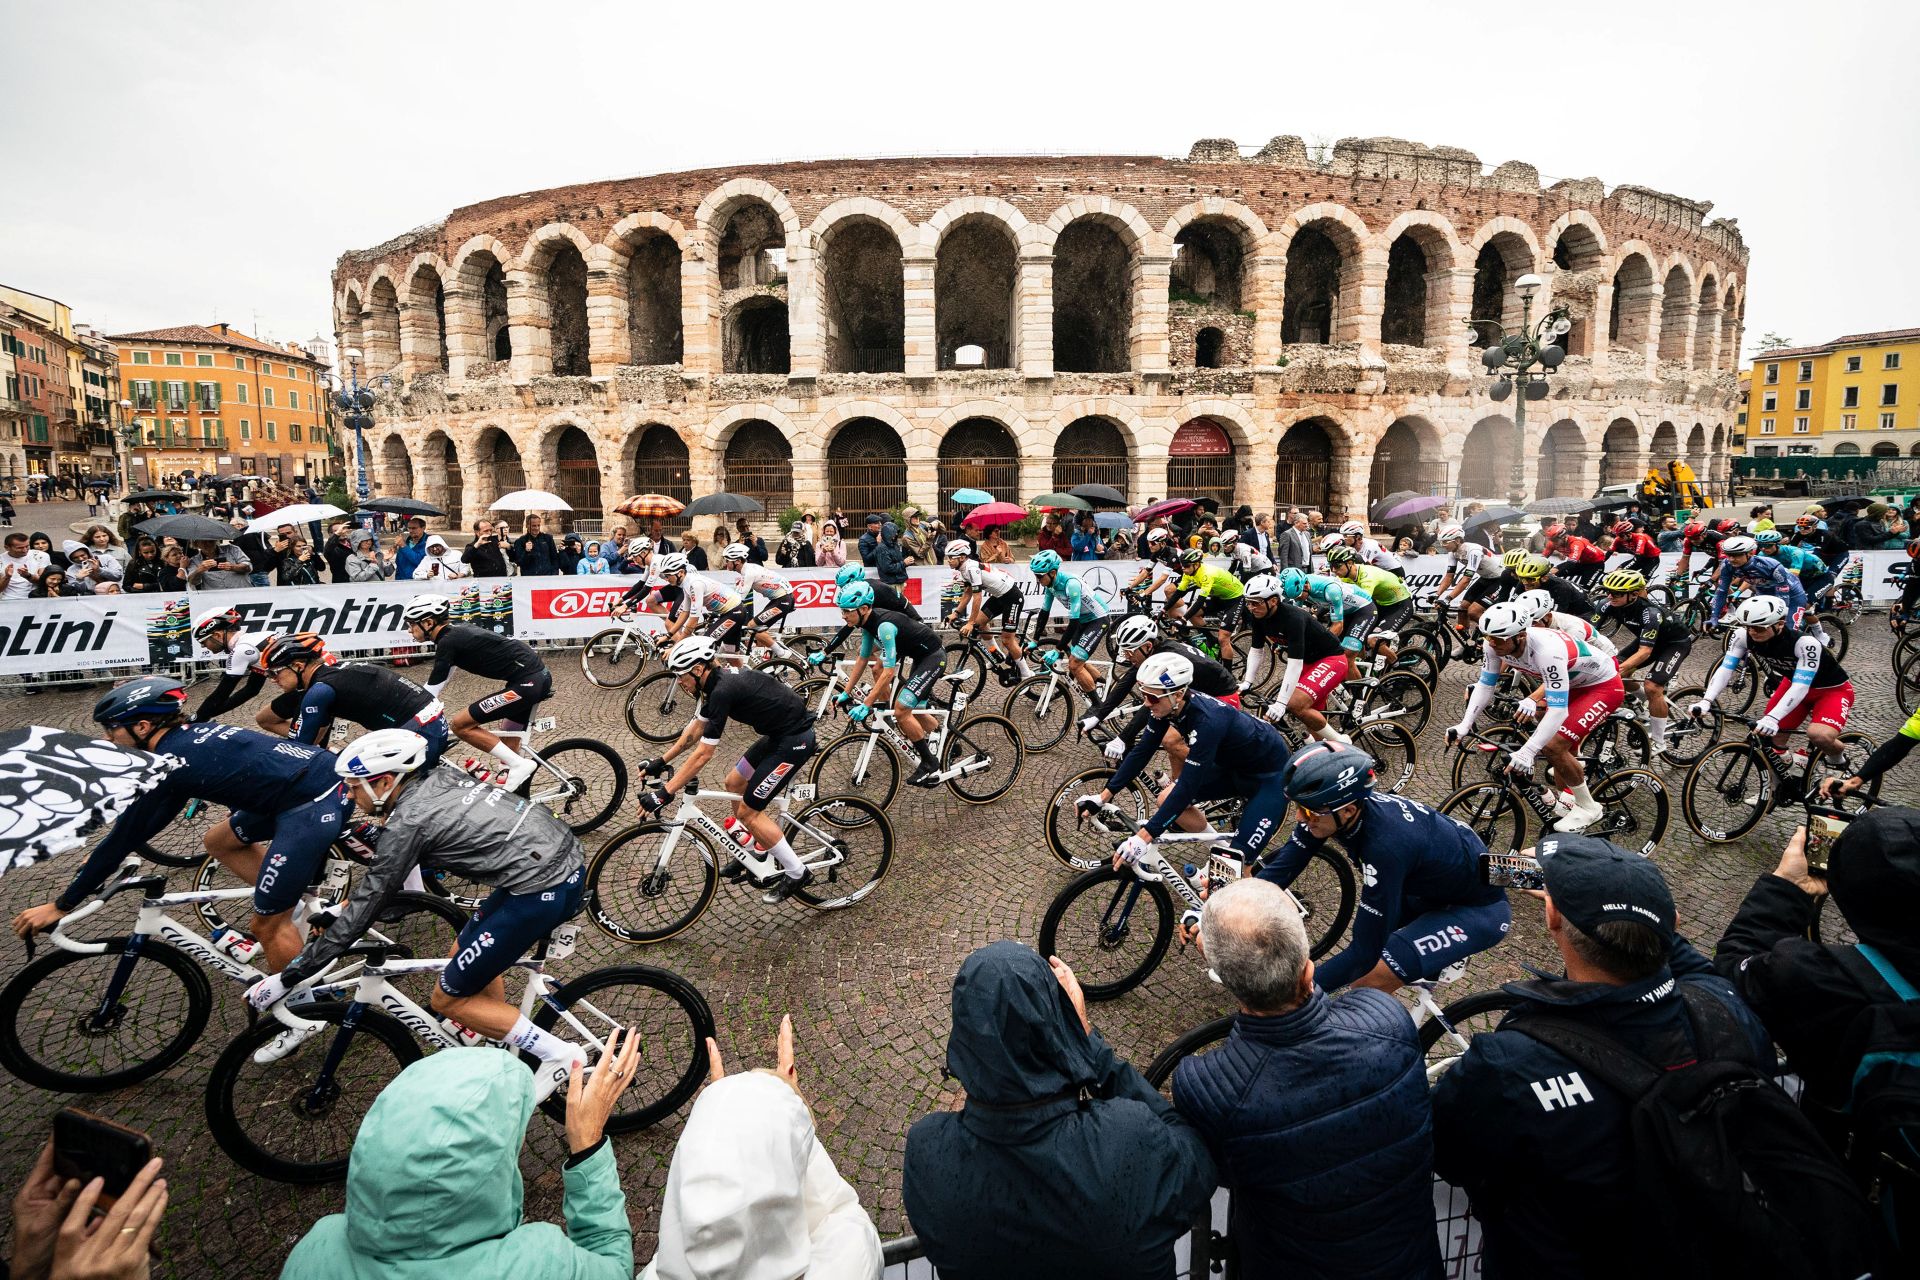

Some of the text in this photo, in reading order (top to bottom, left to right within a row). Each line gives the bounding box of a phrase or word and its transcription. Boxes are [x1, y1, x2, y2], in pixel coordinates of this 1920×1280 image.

[104, 657, 145, 665] DREAMLAND
[1307, 662, 1331, 683] POLTI
[1577, 700, 1608, 728] POLTI
[887, 729, 897, 740] DE
[798, 789, 811, 799] 163
[1522, 786, 1553, 822] AURUM
[1247, 827, 1266, 849] FDJ
[259, 866, 279, 894] FDJ
[333, 867, 348, 879] 42
[1602, 903, 1661, 924] HELLY HANSEN
[558, 933, 574, 947] 45
[1413, 929, 1453, 956] FDJ
[456, 940, 482, 971] FDJ
[1530, 1071, 1594, 1112] HH
